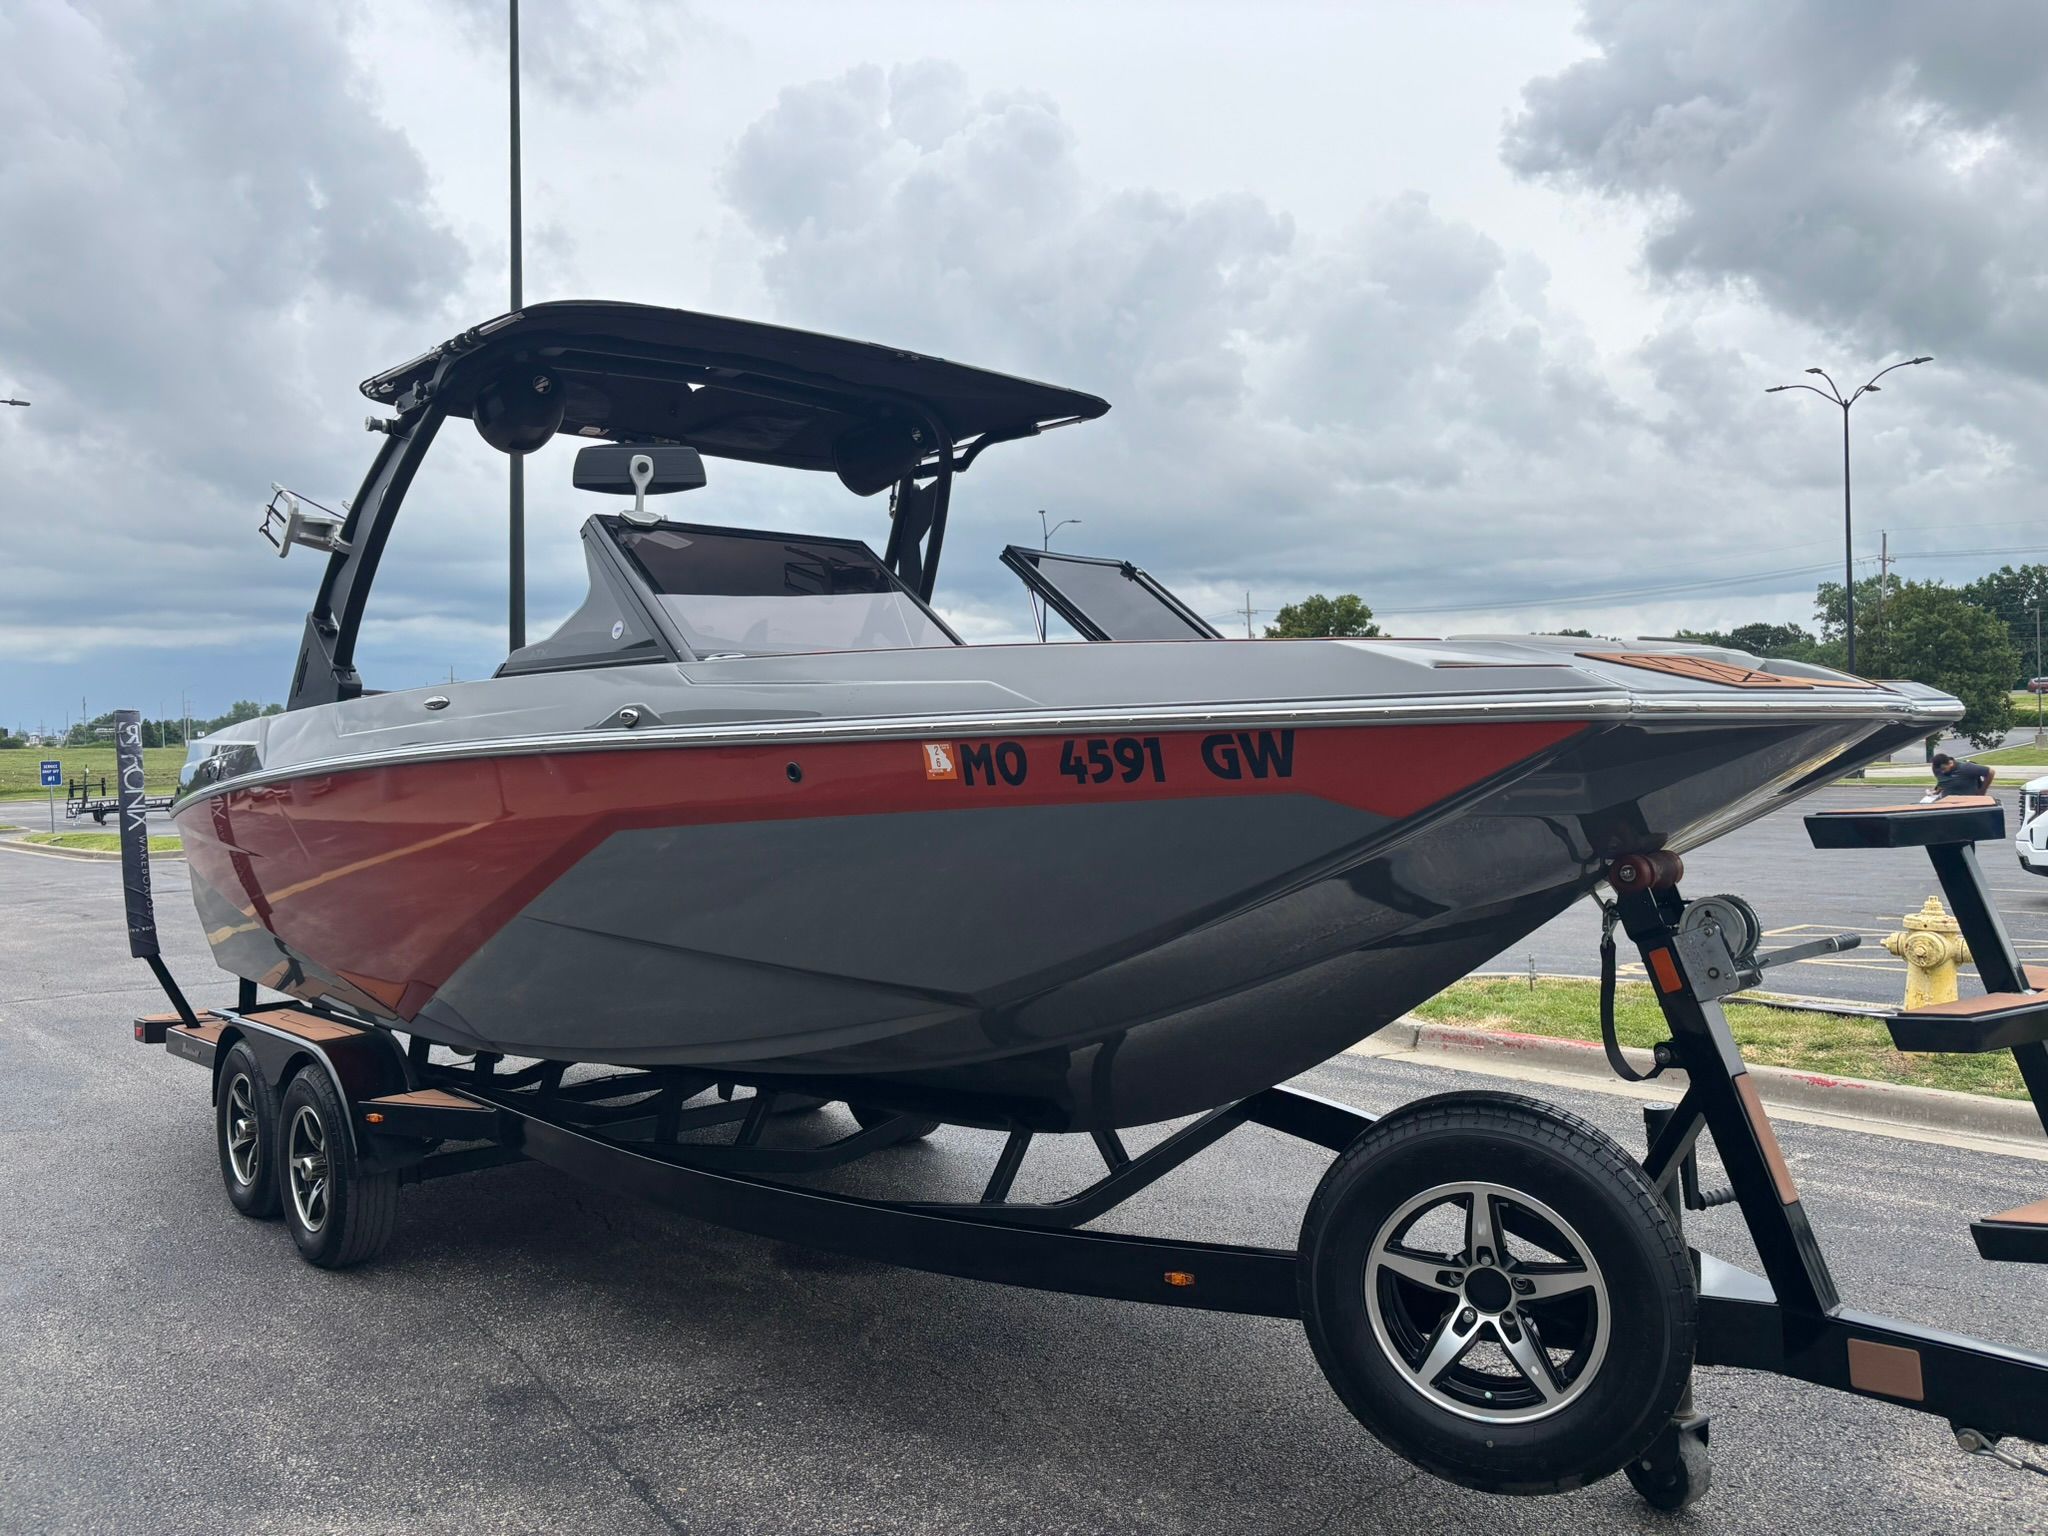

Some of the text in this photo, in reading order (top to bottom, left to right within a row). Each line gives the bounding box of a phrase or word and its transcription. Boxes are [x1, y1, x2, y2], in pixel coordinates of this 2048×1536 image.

[959, 729, 1294, 787] MO 4591 GW
